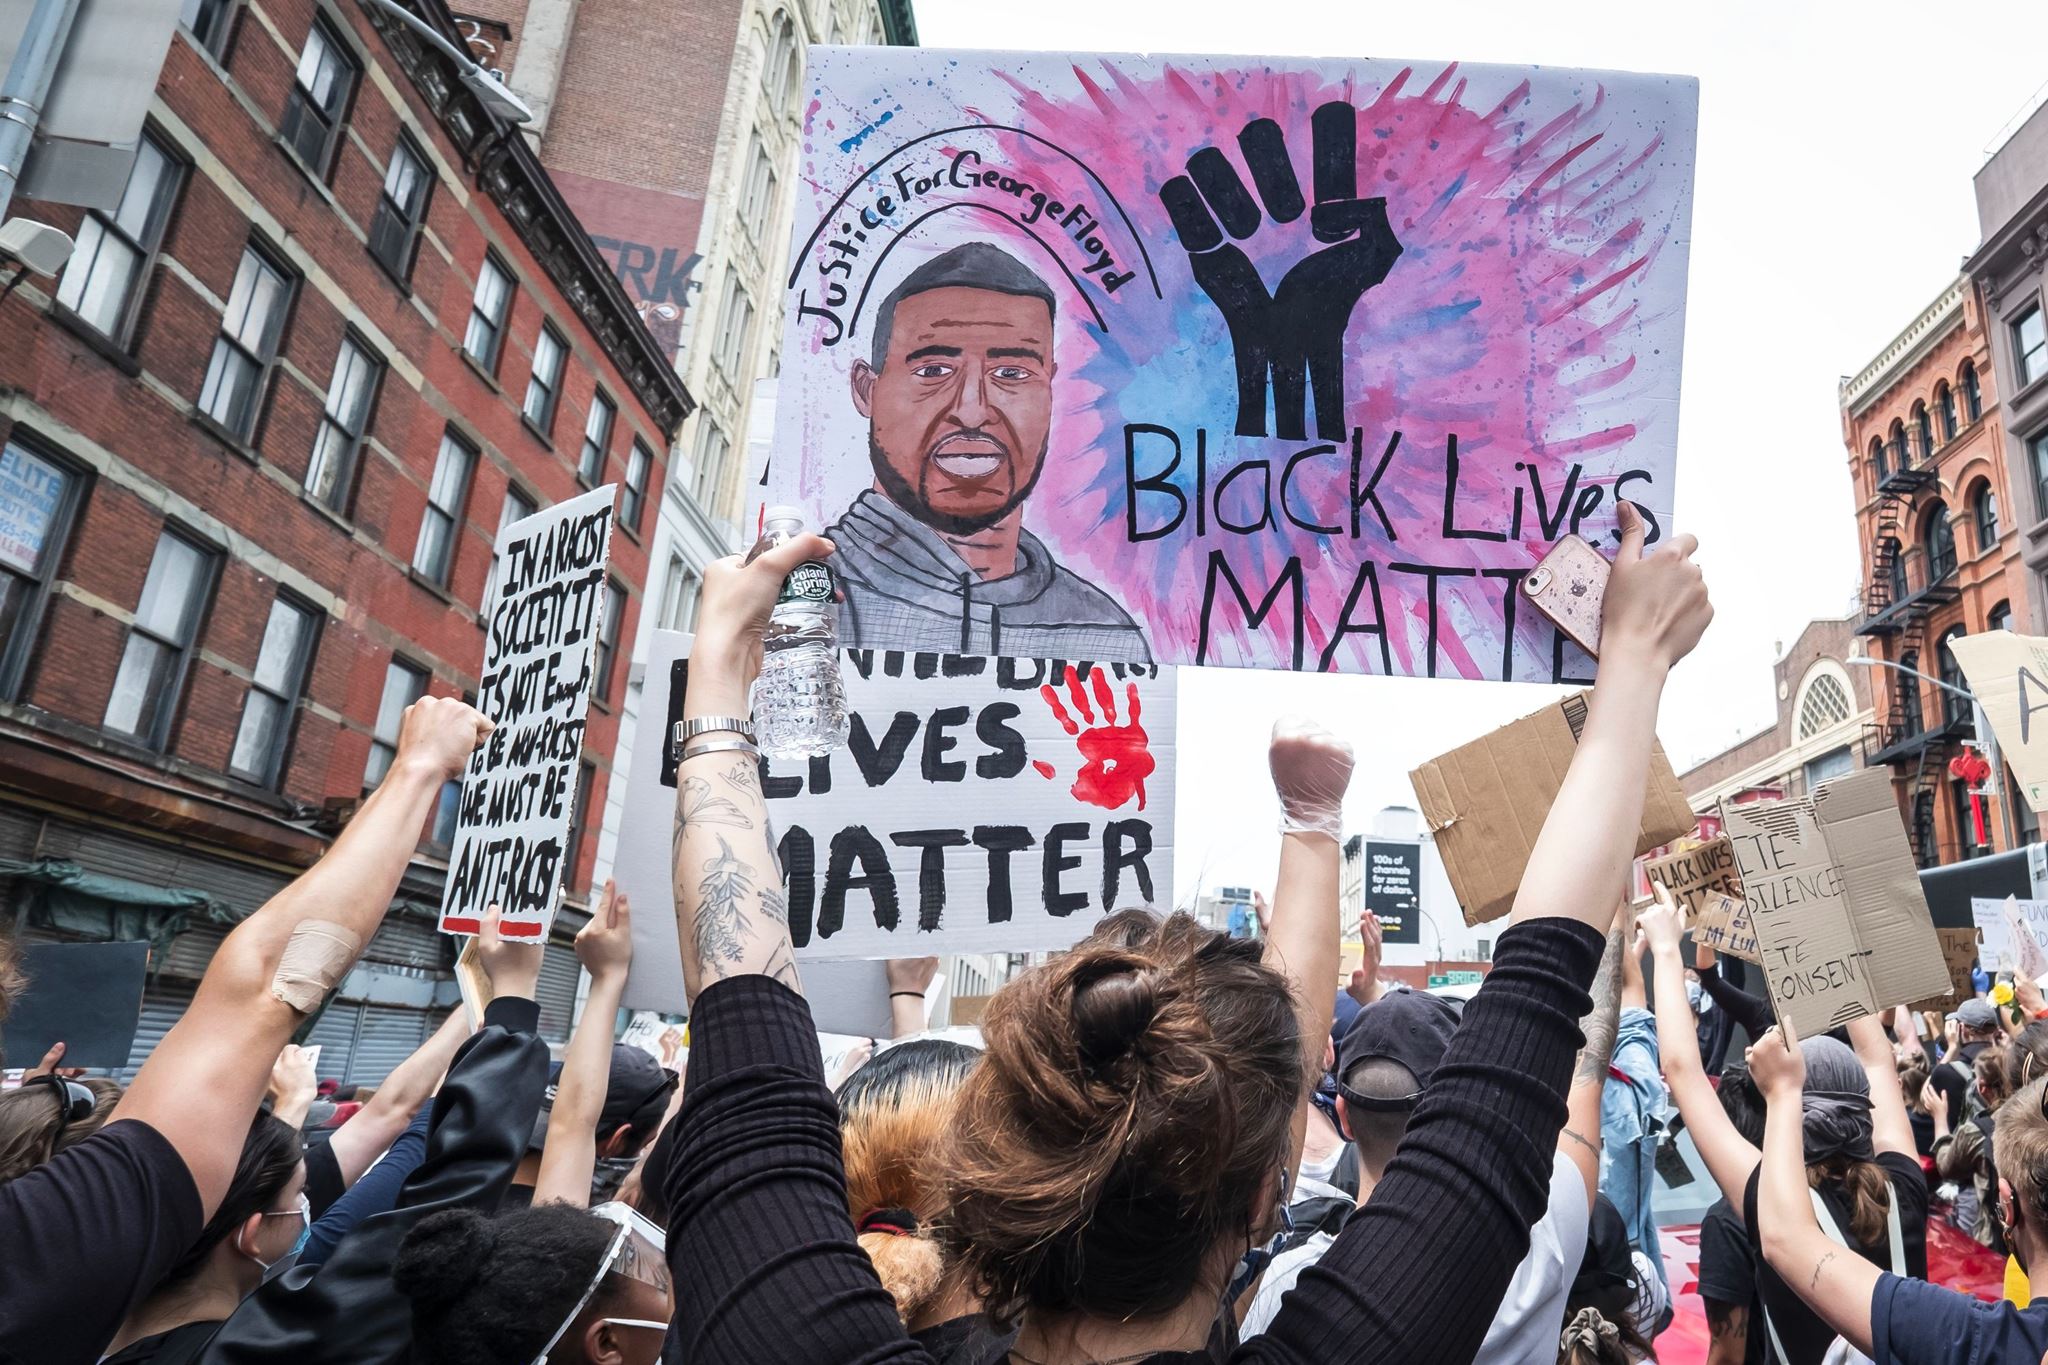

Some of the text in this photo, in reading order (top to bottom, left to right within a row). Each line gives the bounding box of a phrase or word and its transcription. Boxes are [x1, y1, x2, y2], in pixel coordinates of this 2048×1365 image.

[798, 150, 1137, 346] Justice For George Floyd
[503, 504, 613, 598] IN A RACIST
[792, 577, 832, 596] Spring
[488, 568, 604, 669] SOCIETY IT
[506, 658, 546, 725] NOT
[487, 727, 508, 773] BE
[460, 764, 570, 829] WE MUST BE
[445, 836, 563, 915] ANTI-RACIST
[1372, 866, 1411, 876] channels
[1372, 875, 1386, 884] for
[1373, 855, 1404, 865] 100s of
[1650, 859, 1698, 891] BLACK
[1696, 842, 1734, 877] LIVES
[1372, 885, 1414, 895] of dollars.
[1771, 949, 1873, 1002] ONSENT
